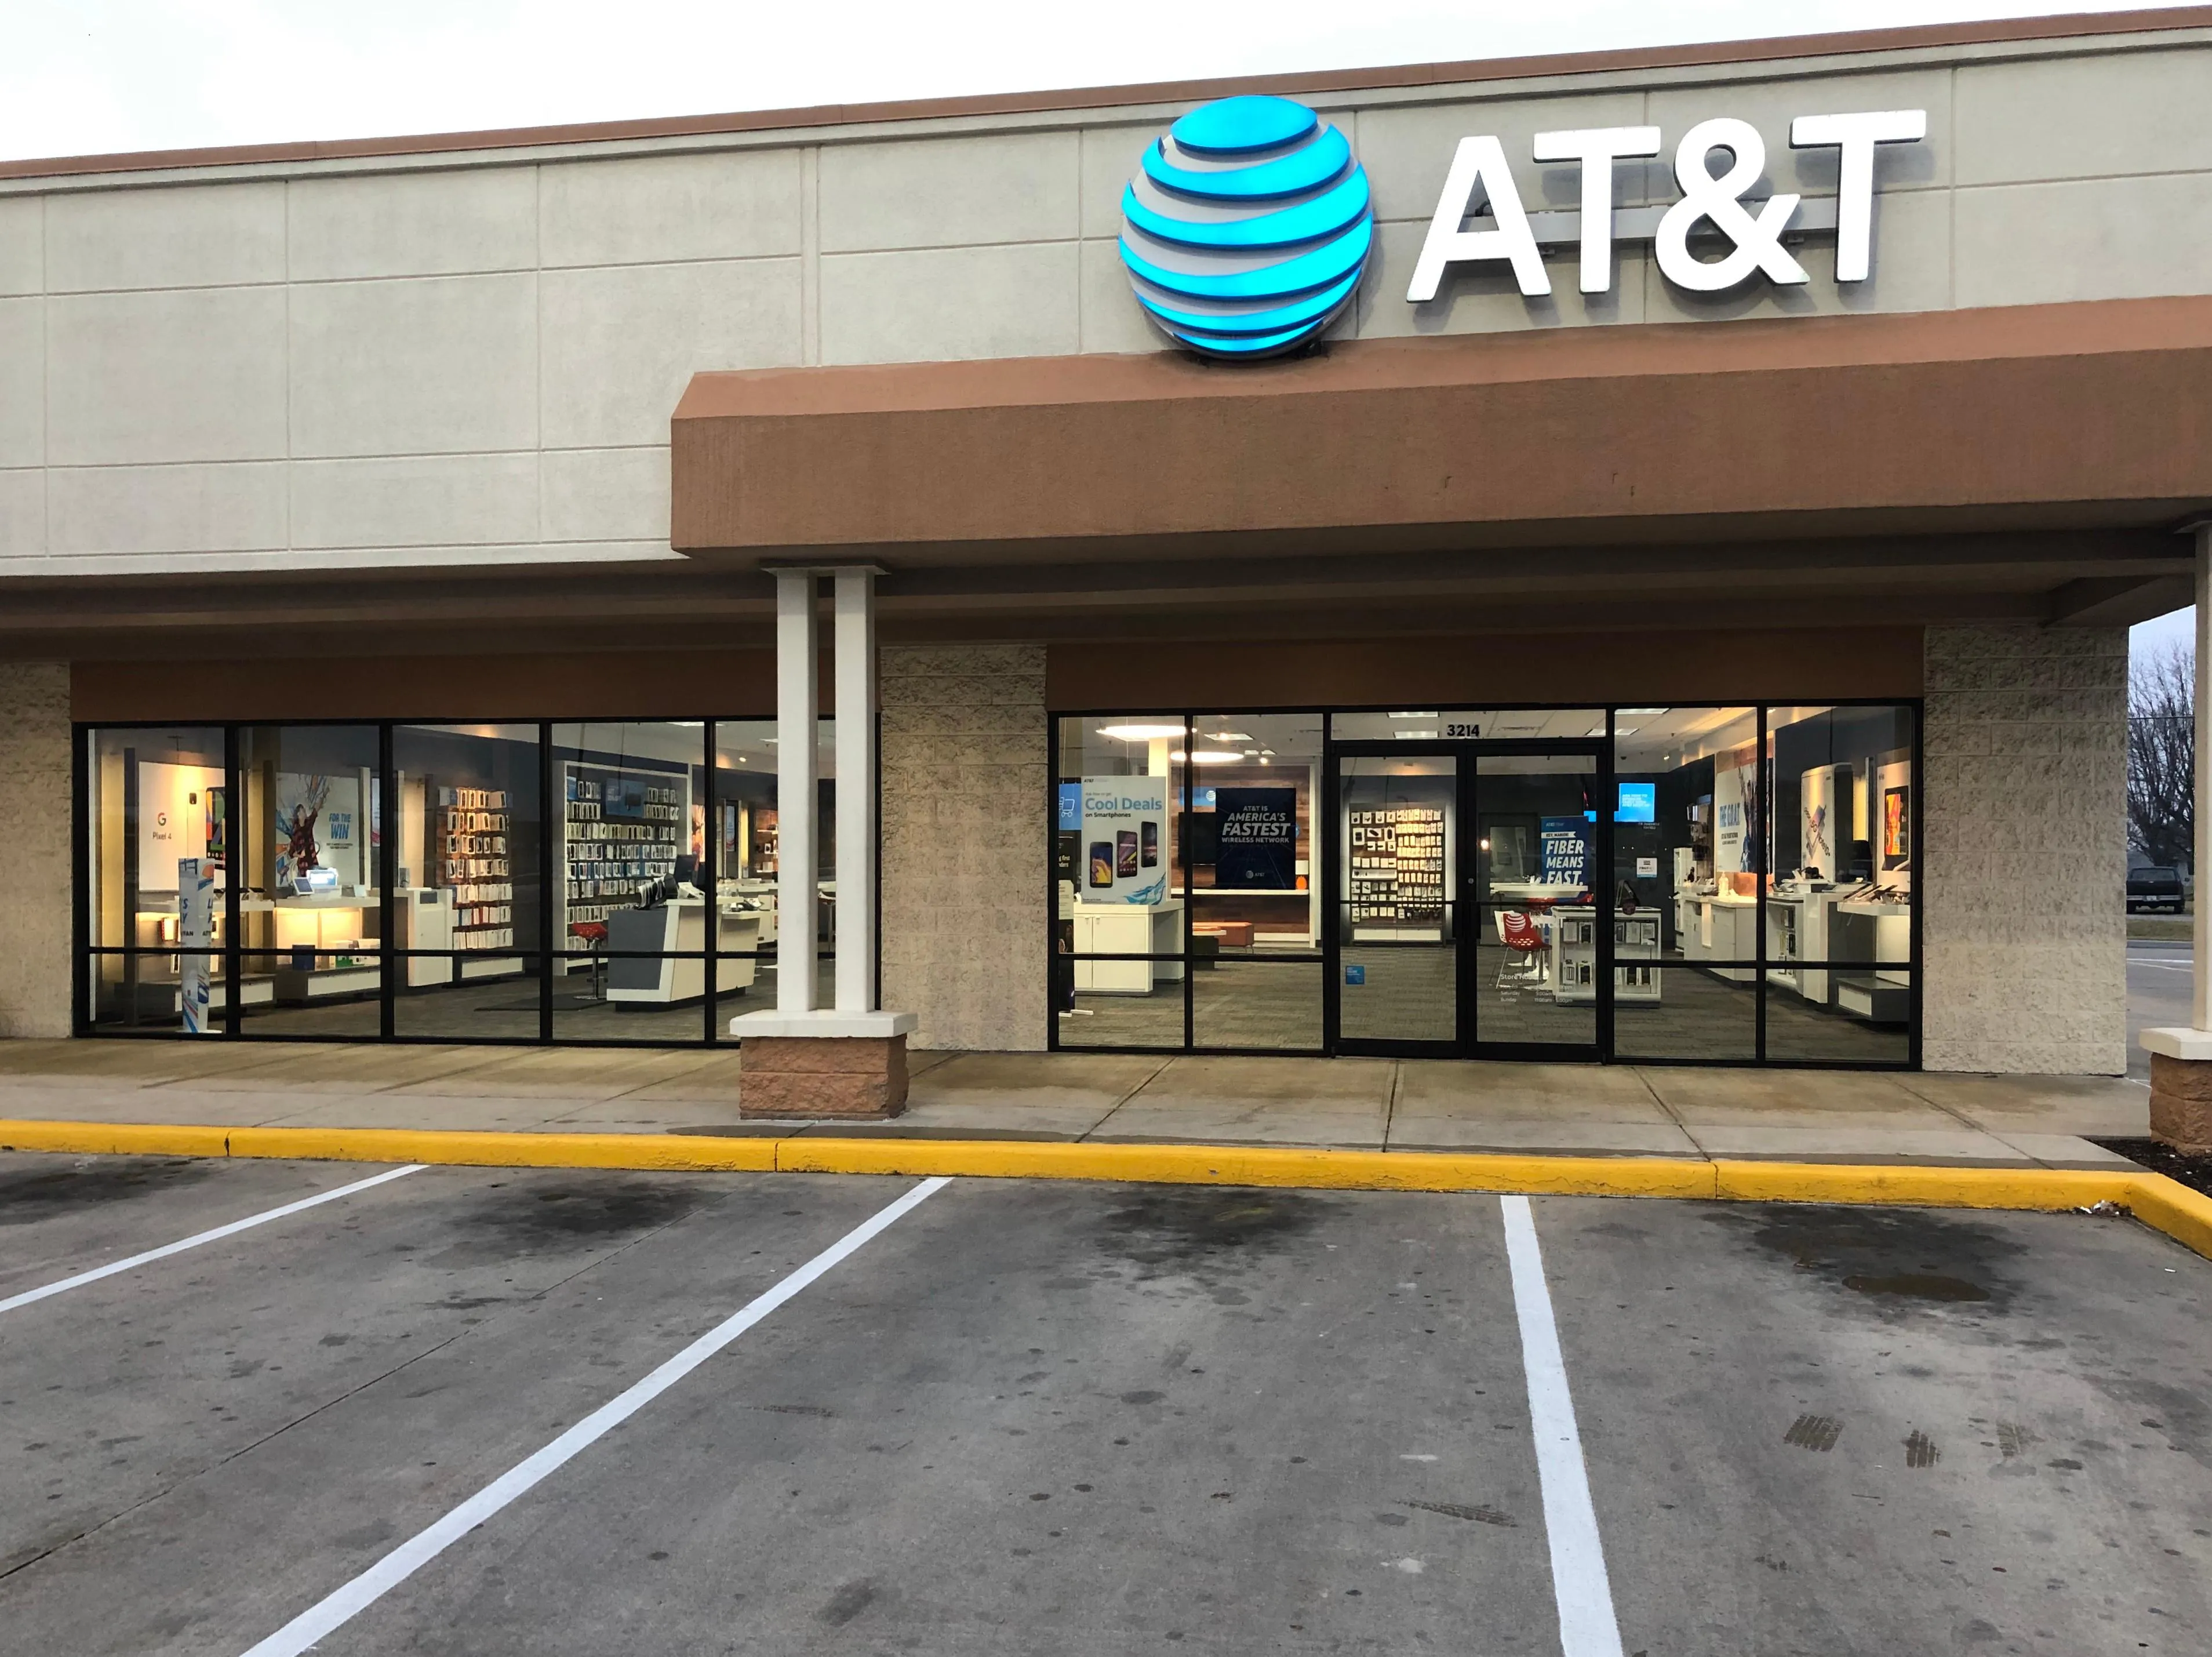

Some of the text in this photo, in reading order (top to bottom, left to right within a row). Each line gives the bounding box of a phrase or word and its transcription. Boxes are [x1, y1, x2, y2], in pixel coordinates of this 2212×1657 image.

[1406, 110, 1926, 303] AT&T
[1447, 724, 1479, 736] 3214
[1085, 797, 1163, 810] Cool Deals
[158, 812, 166, 826] G
[329, 813, 351, 822] FOR THE
[1228, 813, 1286, 821] AMERICA'S
[152, 831, 166, 840] Pixel
[331, 823, 349, 839] WIN
[1222, 822, 1291, 836] FASTEST
[1546, 840, 1584, 855] FIBER
[1546, 856, 1584, 869] MEANS
[1547, 871, 1584, 886] FAST.
